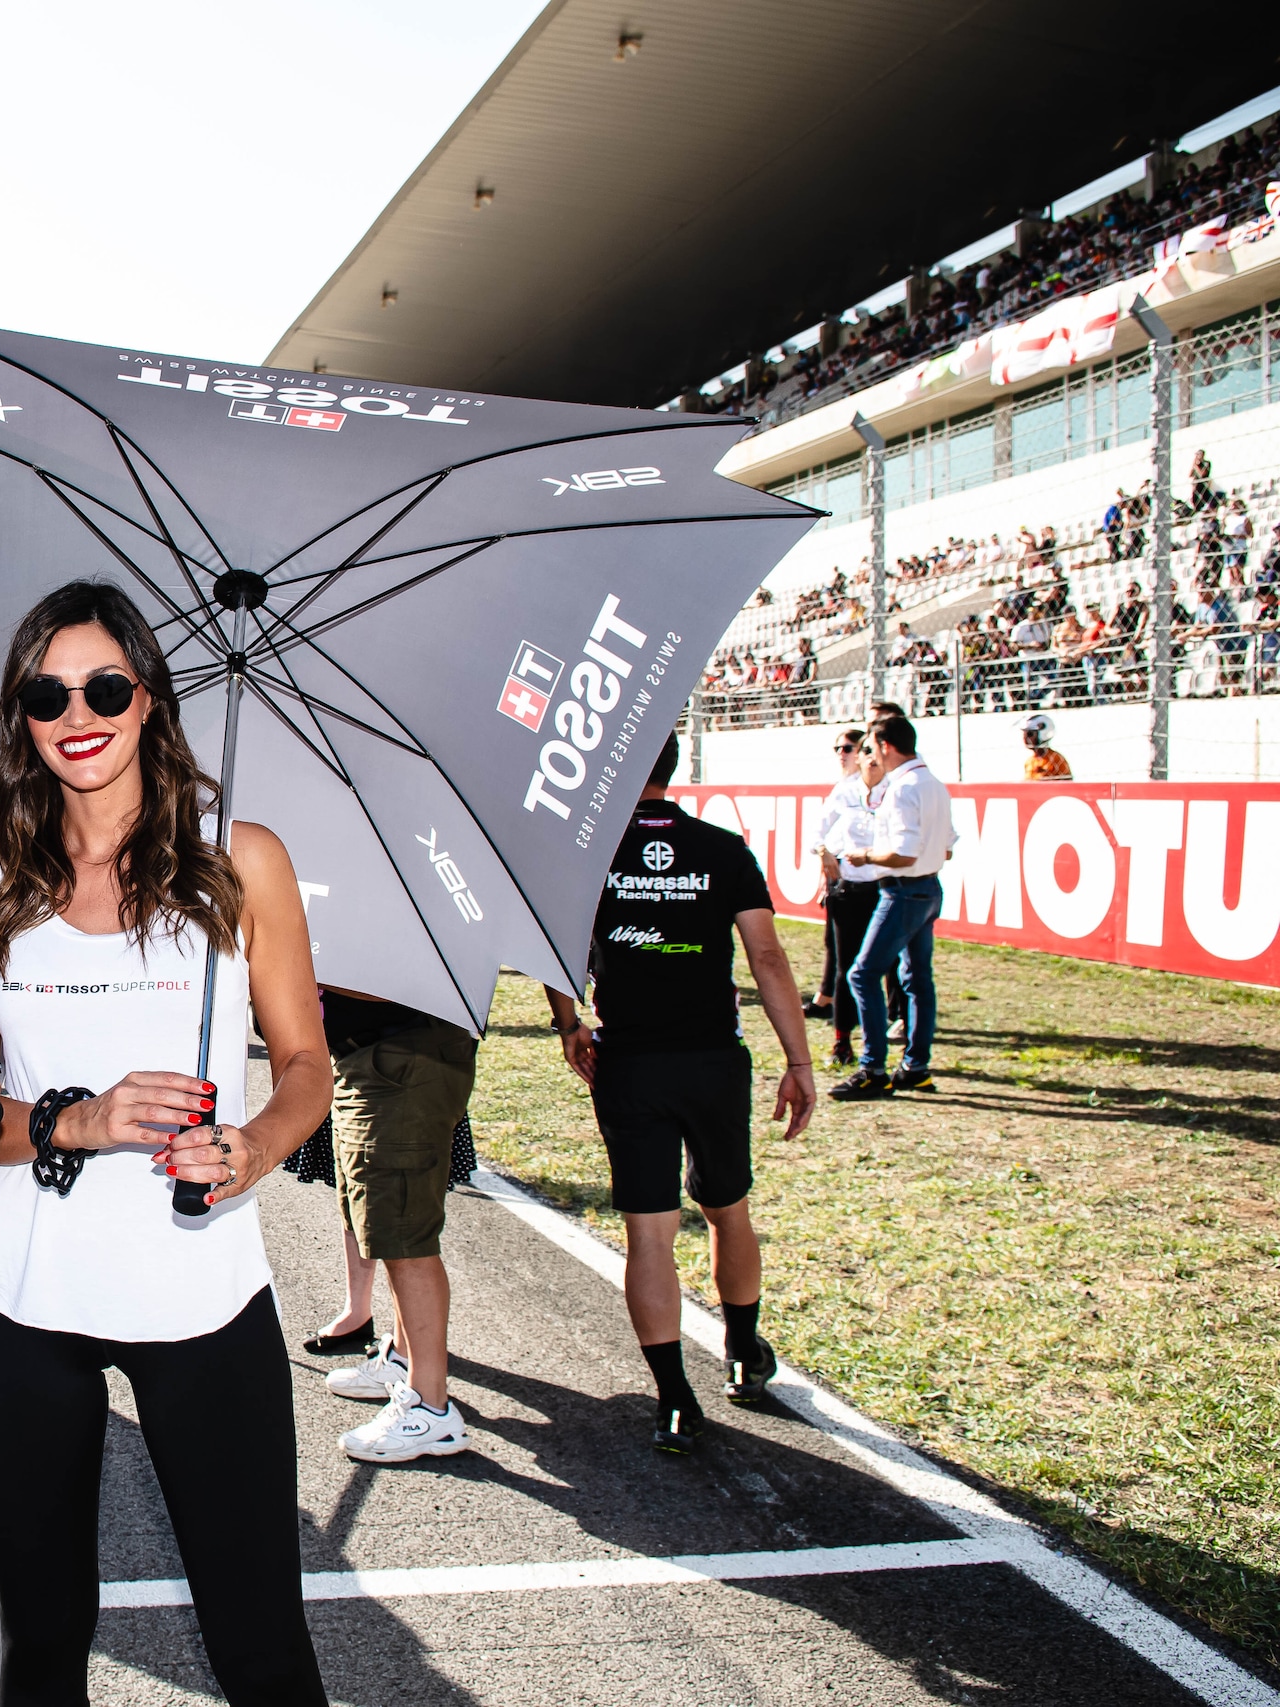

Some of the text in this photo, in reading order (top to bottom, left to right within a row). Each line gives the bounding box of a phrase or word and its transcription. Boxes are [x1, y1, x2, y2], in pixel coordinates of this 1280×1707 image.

[606, 872, 710, 891] Kawasaki
[617, 890, 696, 902] Racing Team
[608, 925, 665, 948] Ninja
[55, 984, 109, 994] TISSOT
[112, 980, 191, 992] SUPERPOLE
[402, 1424, 420, 1432] FILA
